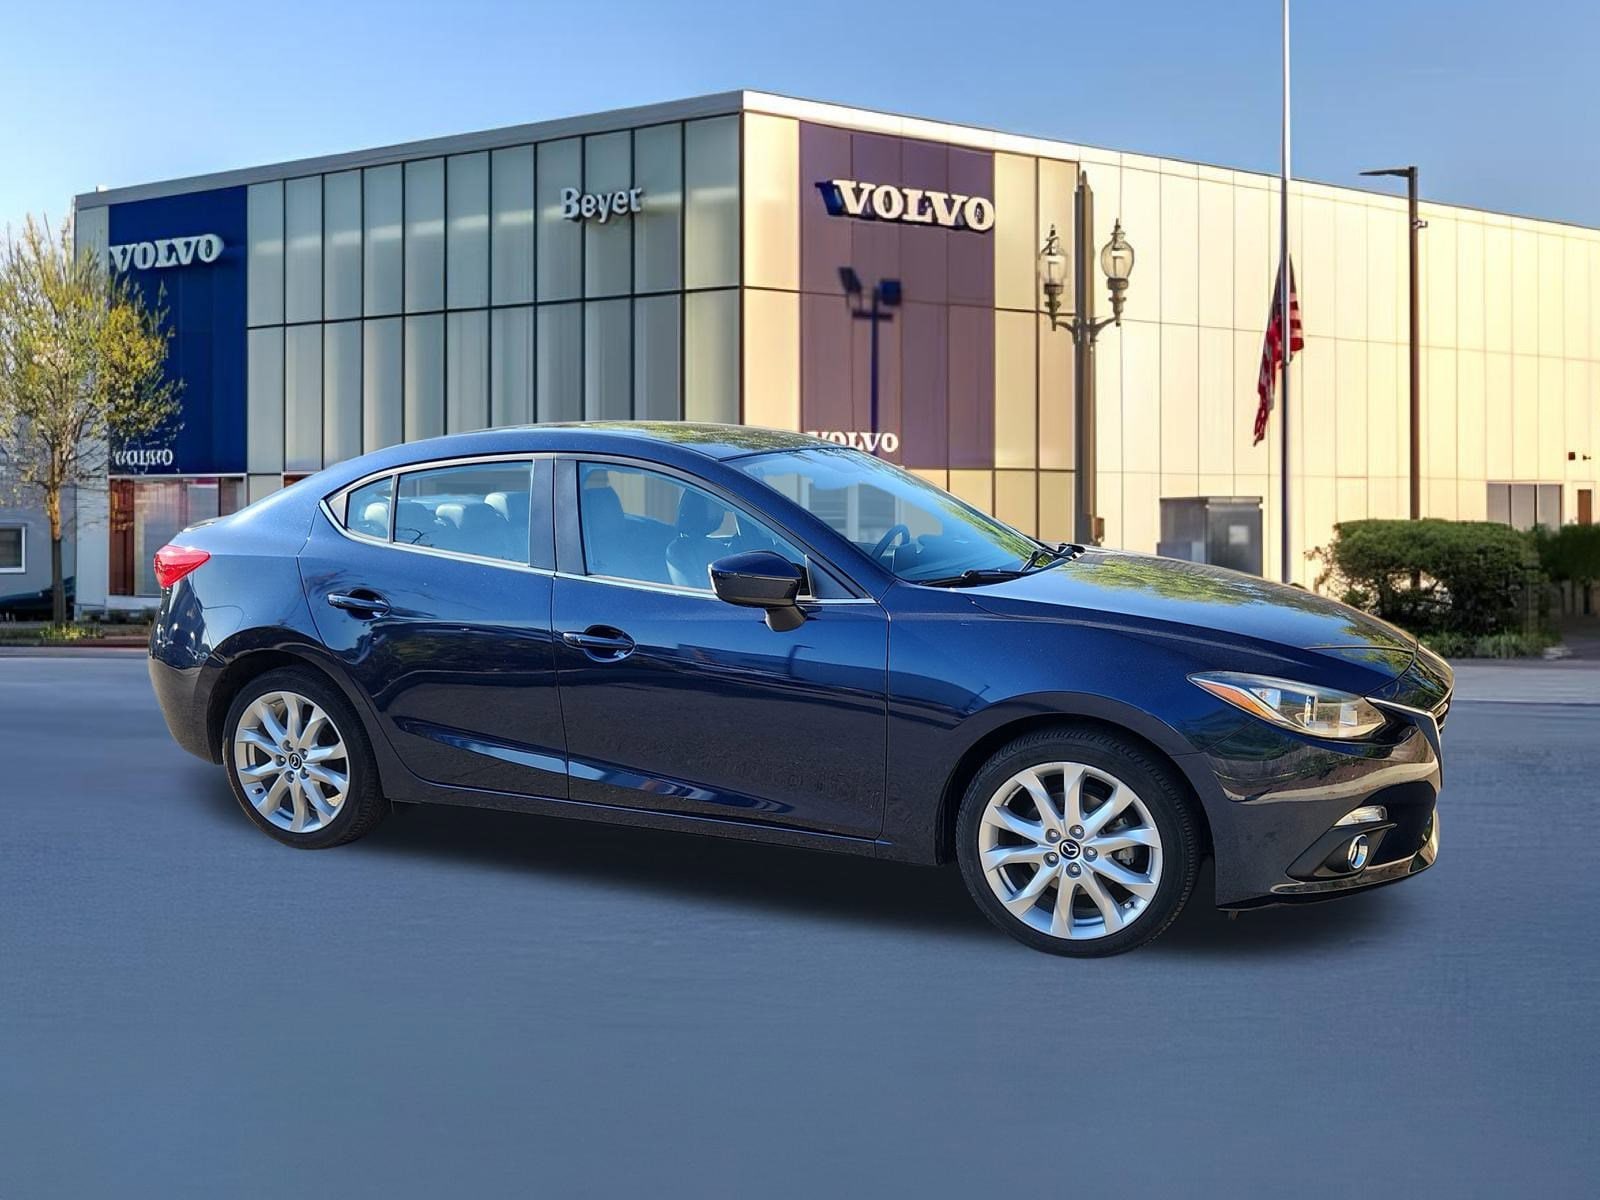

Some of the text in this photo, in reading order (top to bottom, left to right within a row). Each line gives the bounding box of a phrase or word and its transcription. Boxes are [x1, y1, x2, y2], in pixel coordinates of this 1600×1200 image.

[560, 187, 642, 223] Beyer
[832, 179, 995, 231] VOLVO
[109, 233, 224, 272] VOLVO
